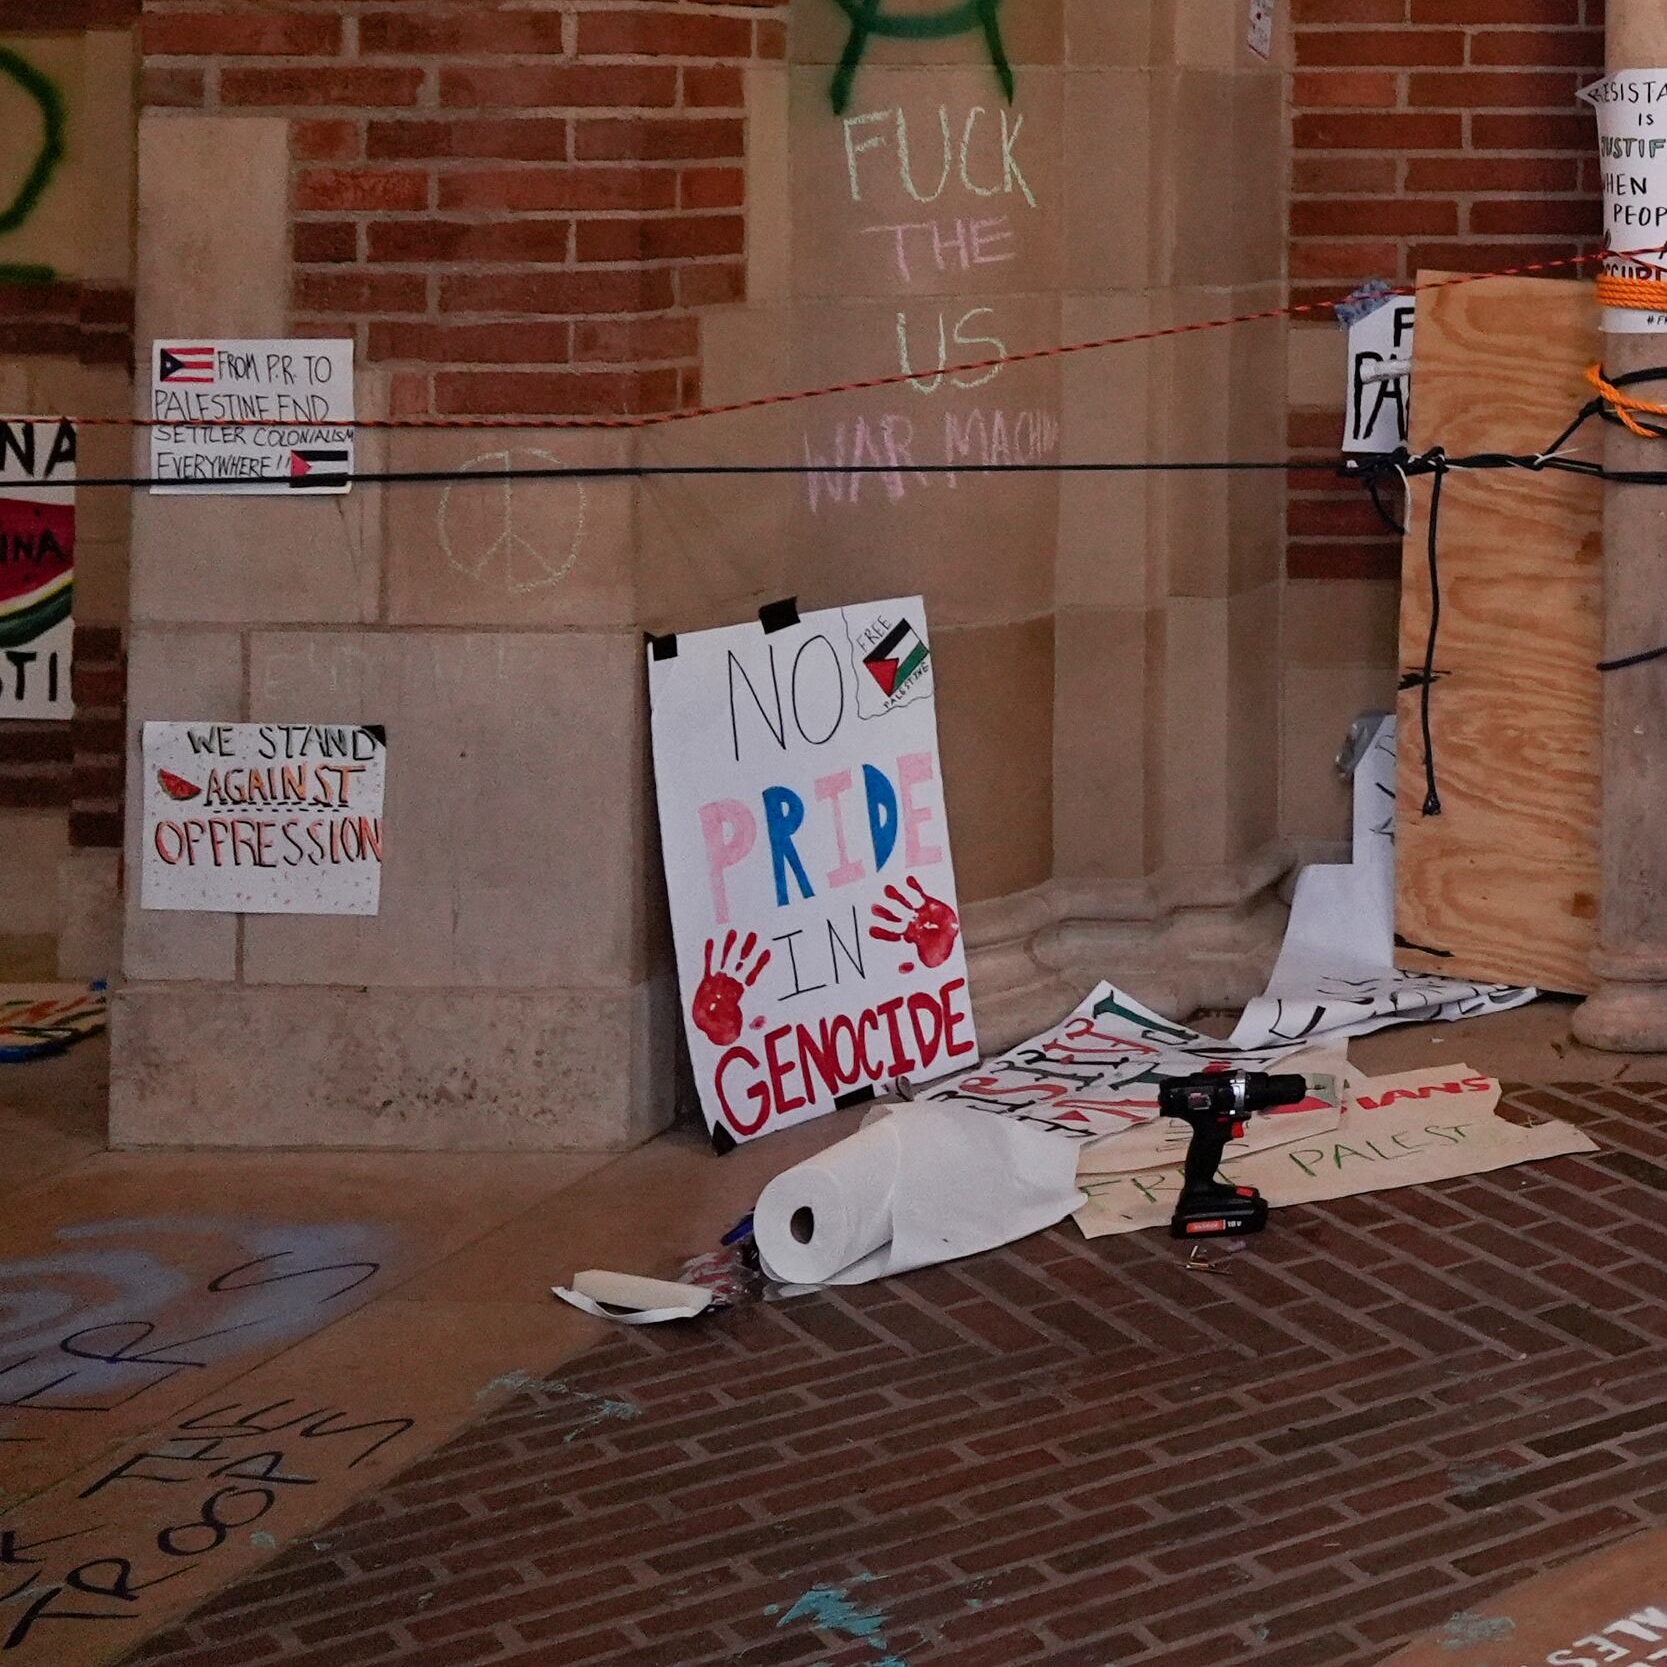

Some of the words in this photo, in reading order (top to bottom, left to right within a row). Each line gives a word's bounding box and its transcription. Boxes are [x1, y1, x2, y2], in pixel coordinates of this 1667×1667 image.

[1637, 112, 1655, 127] IS
[842, 107, 1037, 209] FUCK
[1600, 172, 1648, 196] HEN
[860, 214, 1017, 282] THE
[217, 350, 259, 383] FROM
[304, 355, 332, 384] TO
[896, 307, 1008, 396] US
[154, 389, 270, 421] PALESTINE
[278, 395, 329, 422] END
[154, 425, 247, 444] SETTLER
[253, 428, 354, 446] COLONIALISM
[803, 415, 928, 514] WAR
[854, 614, 893, 655] FREE
[727, 634, 845, 761] NO
[883, 660, 931, 710] PALESTINE
[187, 726, 237, 757] WE
[259, 725, 376, 762] STAND
[204, 764, 366, 807] AGAINST
[155, 815, 384, 869] OPPRESSION
[698, 750, 943, 925] PRIDE
[772, 904, 867, 1002] IN
[713, 977, 975, 1137] GENOCIDE
